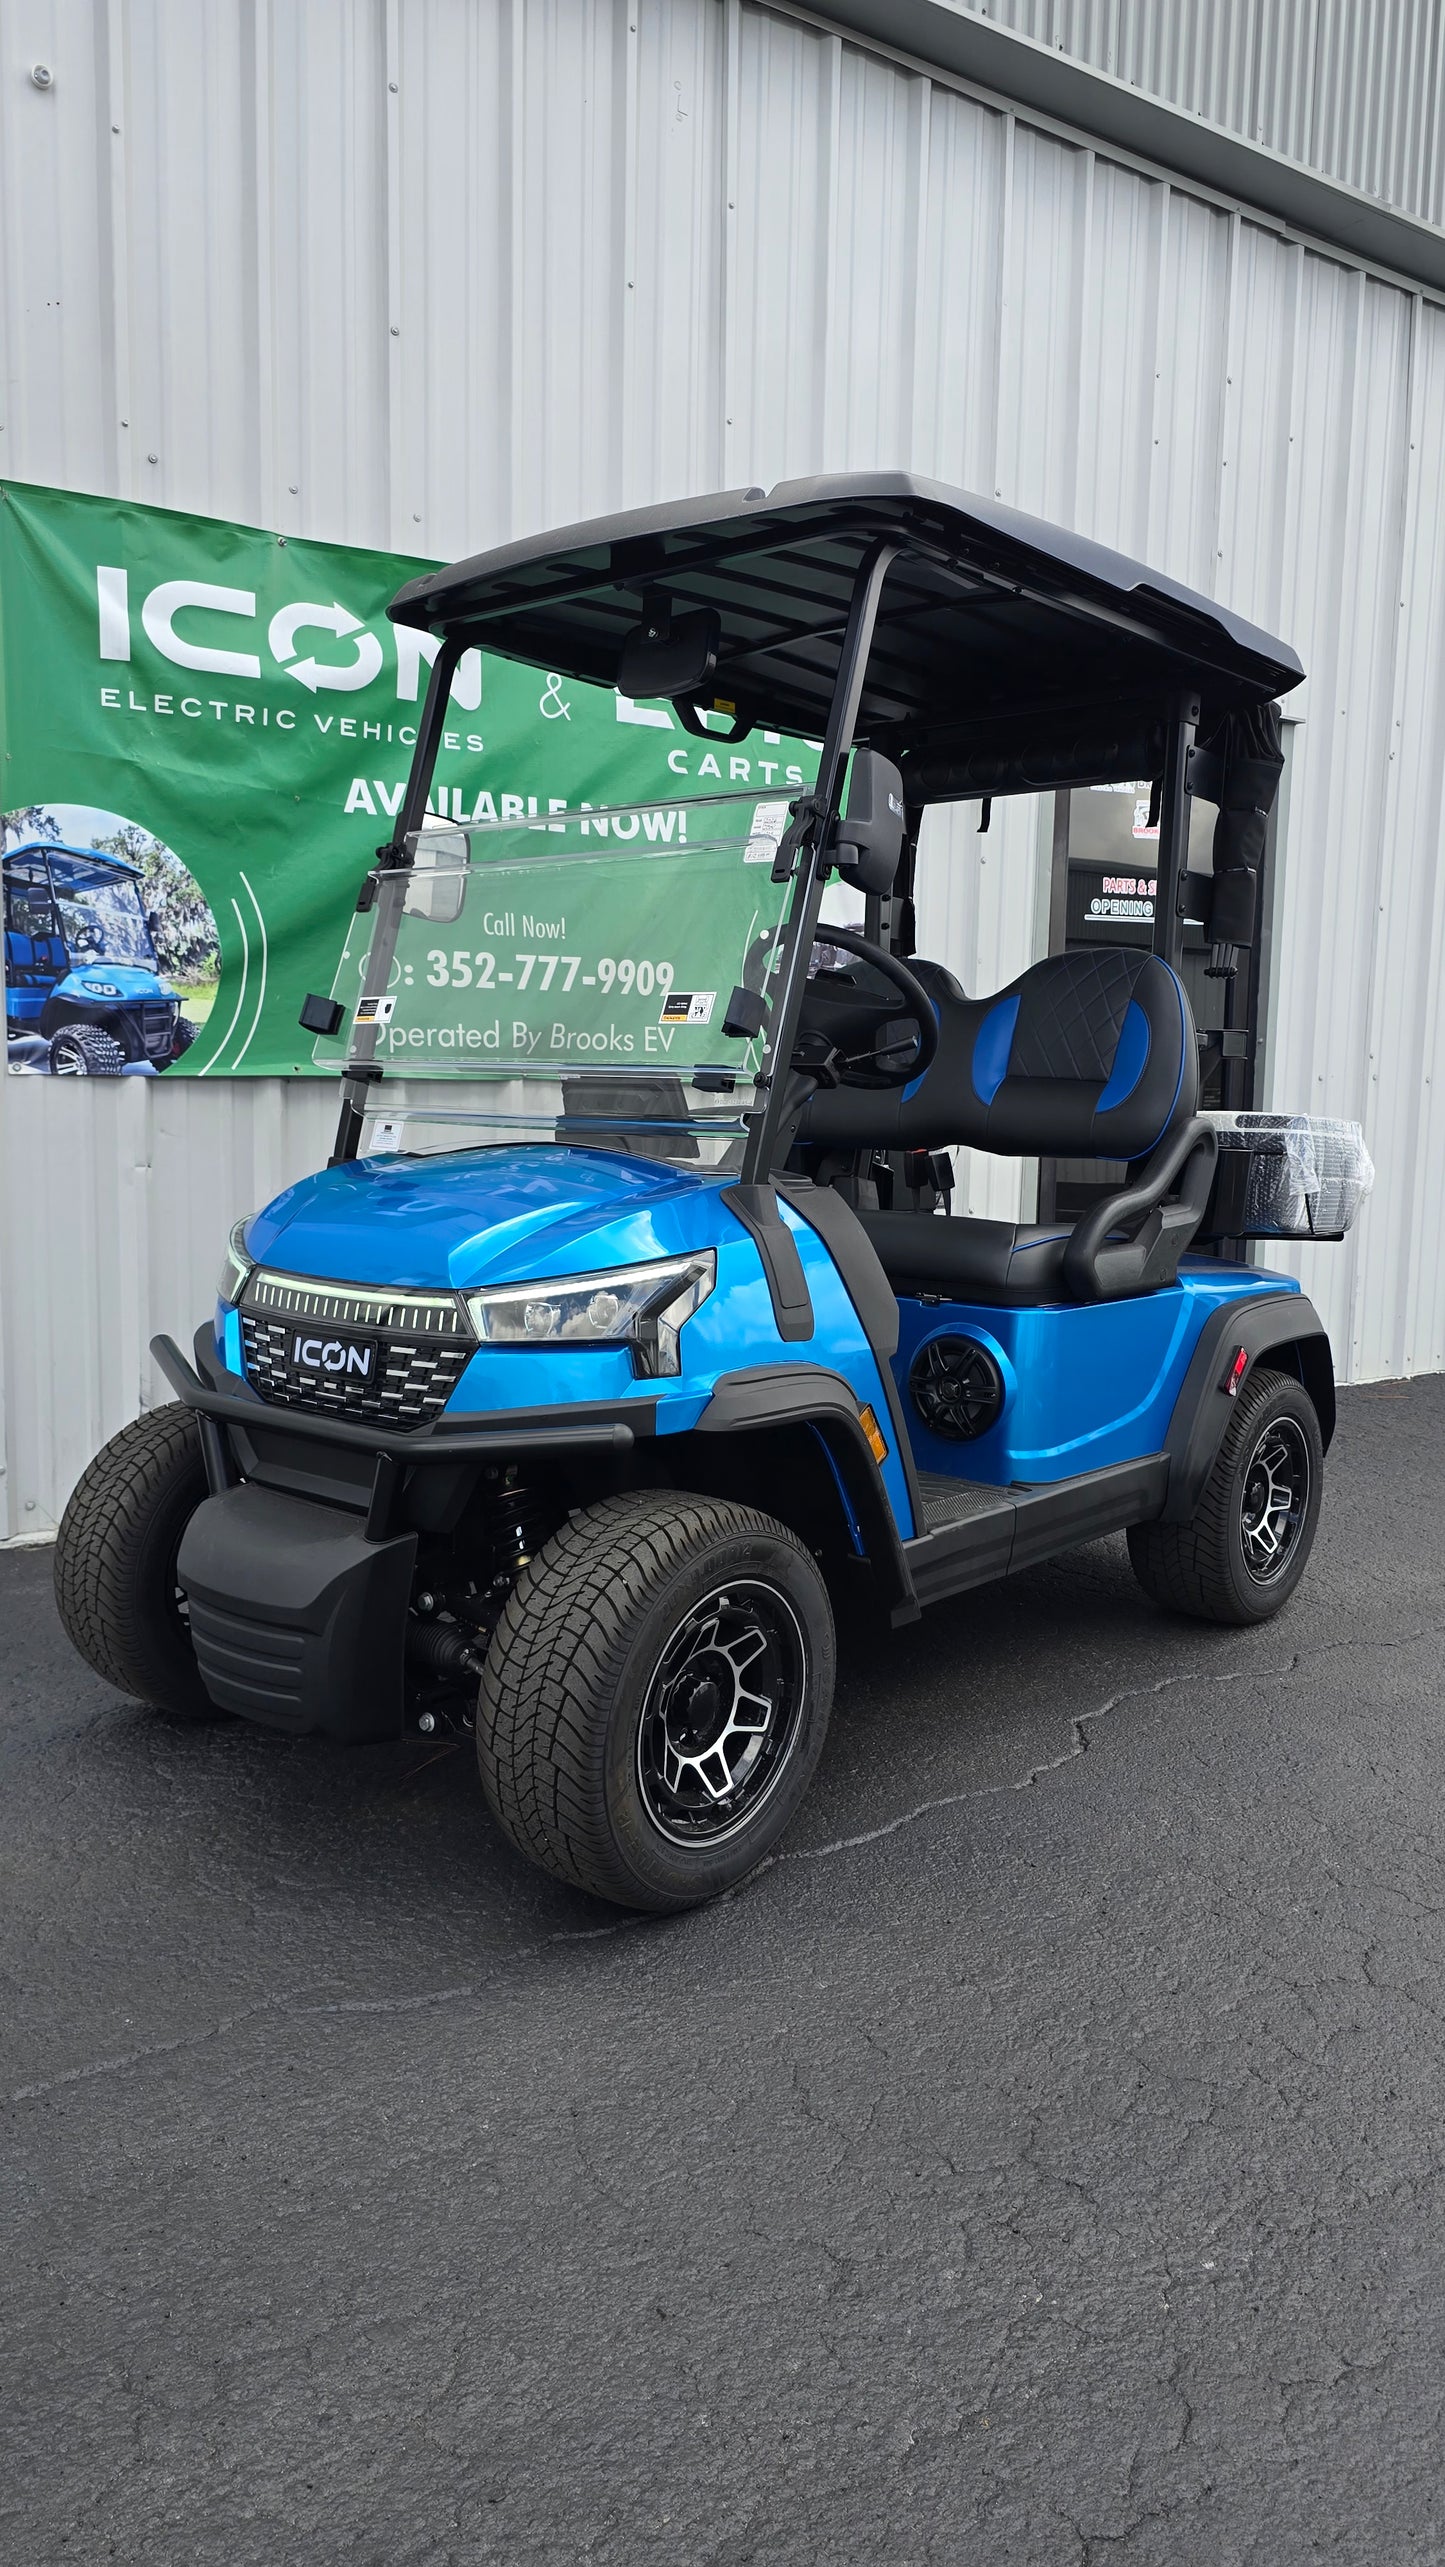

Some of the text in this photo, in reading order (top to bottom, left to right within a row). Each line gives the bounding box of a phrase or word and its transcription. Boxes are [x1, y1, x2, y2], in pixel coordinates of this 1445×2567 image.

[97, 565, 482, 711] ICON
[539, 671, 572, 721] &
[100, 688, 484, 752] ELECTRIC VEHICES
[667, 750, 803, 785] CARTS
[343, 778, 568, 833] AVILABLE
[580, 802, 687, 844] NOW!
[1103, 877, 1136, 894] PARTS
[1137, 879, 1147, 895] &
[483, 912, 567, 940] Call Now!
[1090, 898, 1154, 916] OPENING
[426, 949, 675, 996] 352-777-9909
[513, 1022, 541, 1059] By
[550, 1024, 634, 1053] Brooks
[644, 1026, 676, 1053] EV
[294, 1336, 371, 1376] ICON
